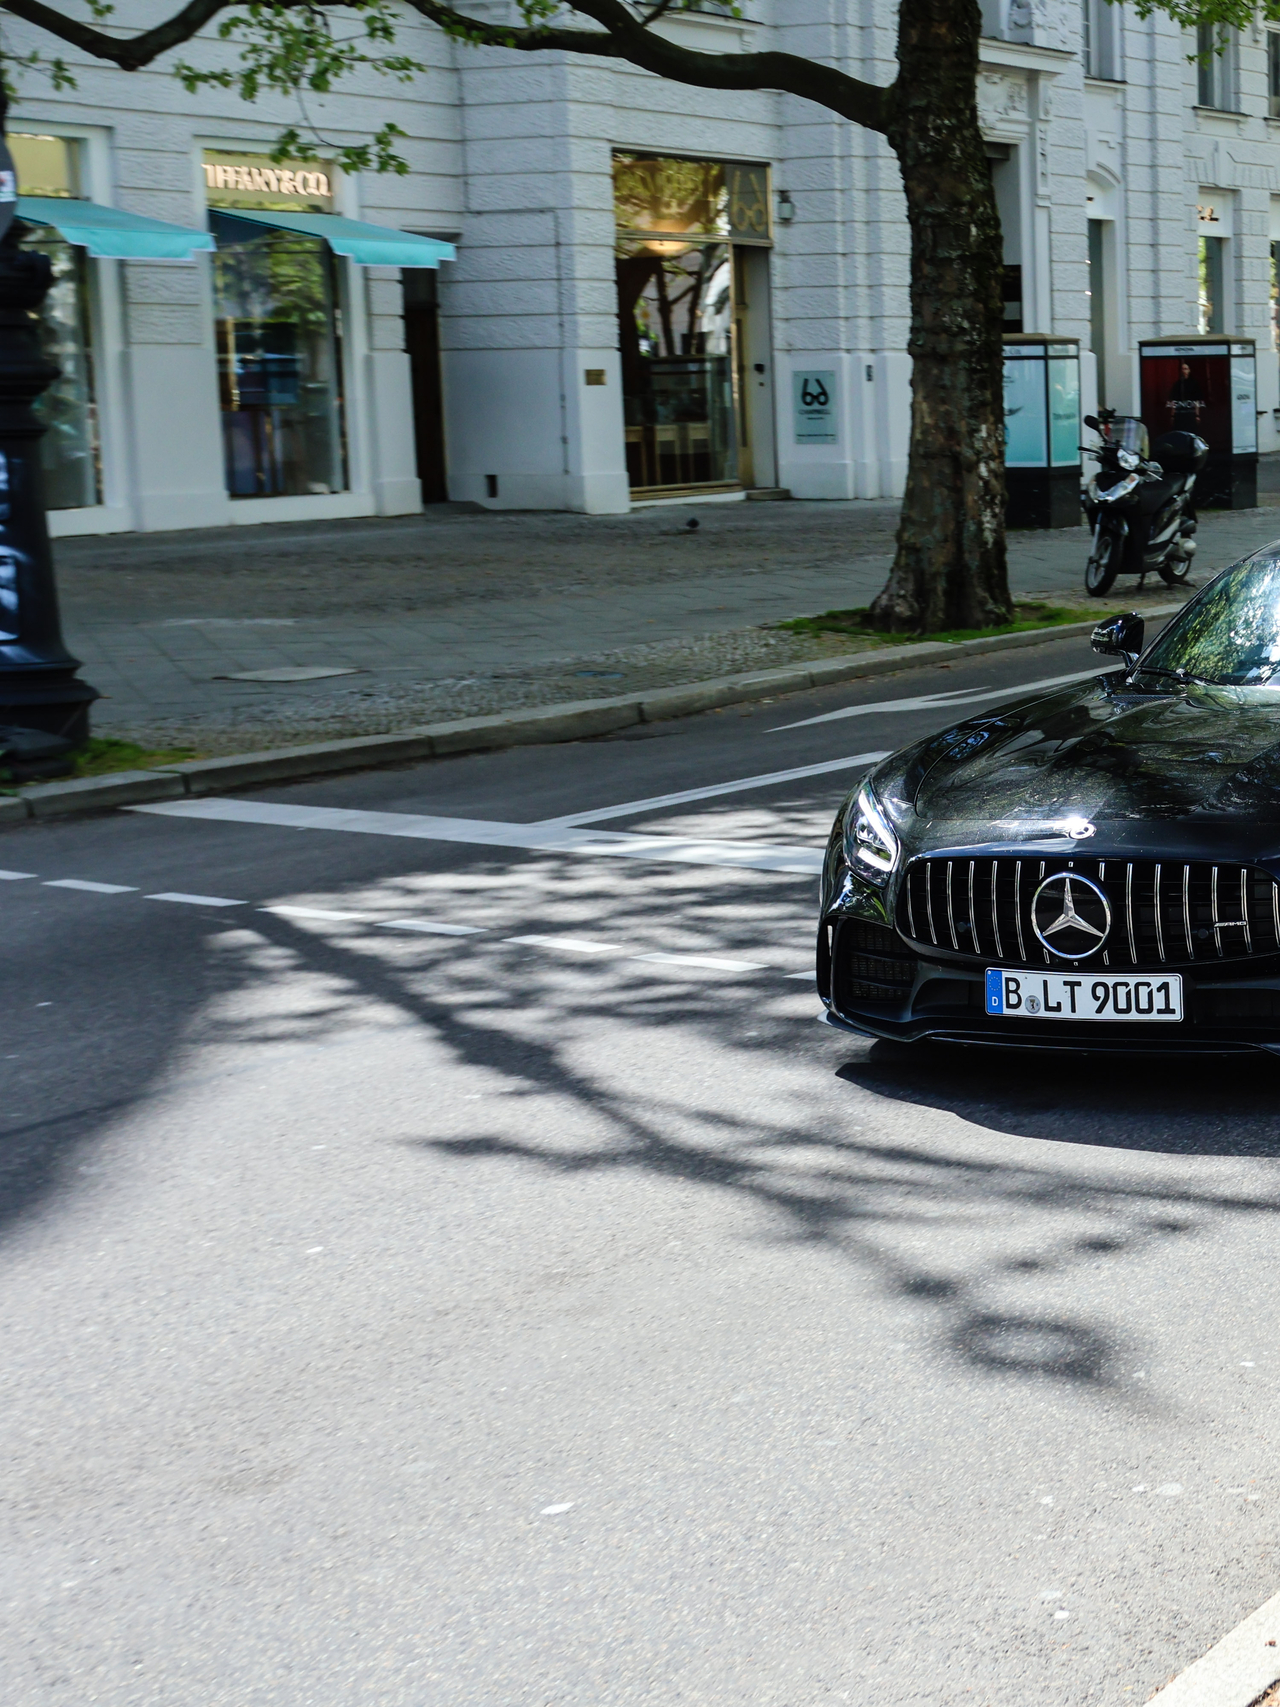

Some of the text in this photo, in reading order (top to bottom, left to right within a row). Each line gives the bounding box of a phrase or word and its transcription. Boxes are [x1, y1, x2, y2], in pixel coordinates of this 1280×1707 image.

[991, 996, 998, 1006] D
[1004, 977, 1176, 1015] B LT 9001
